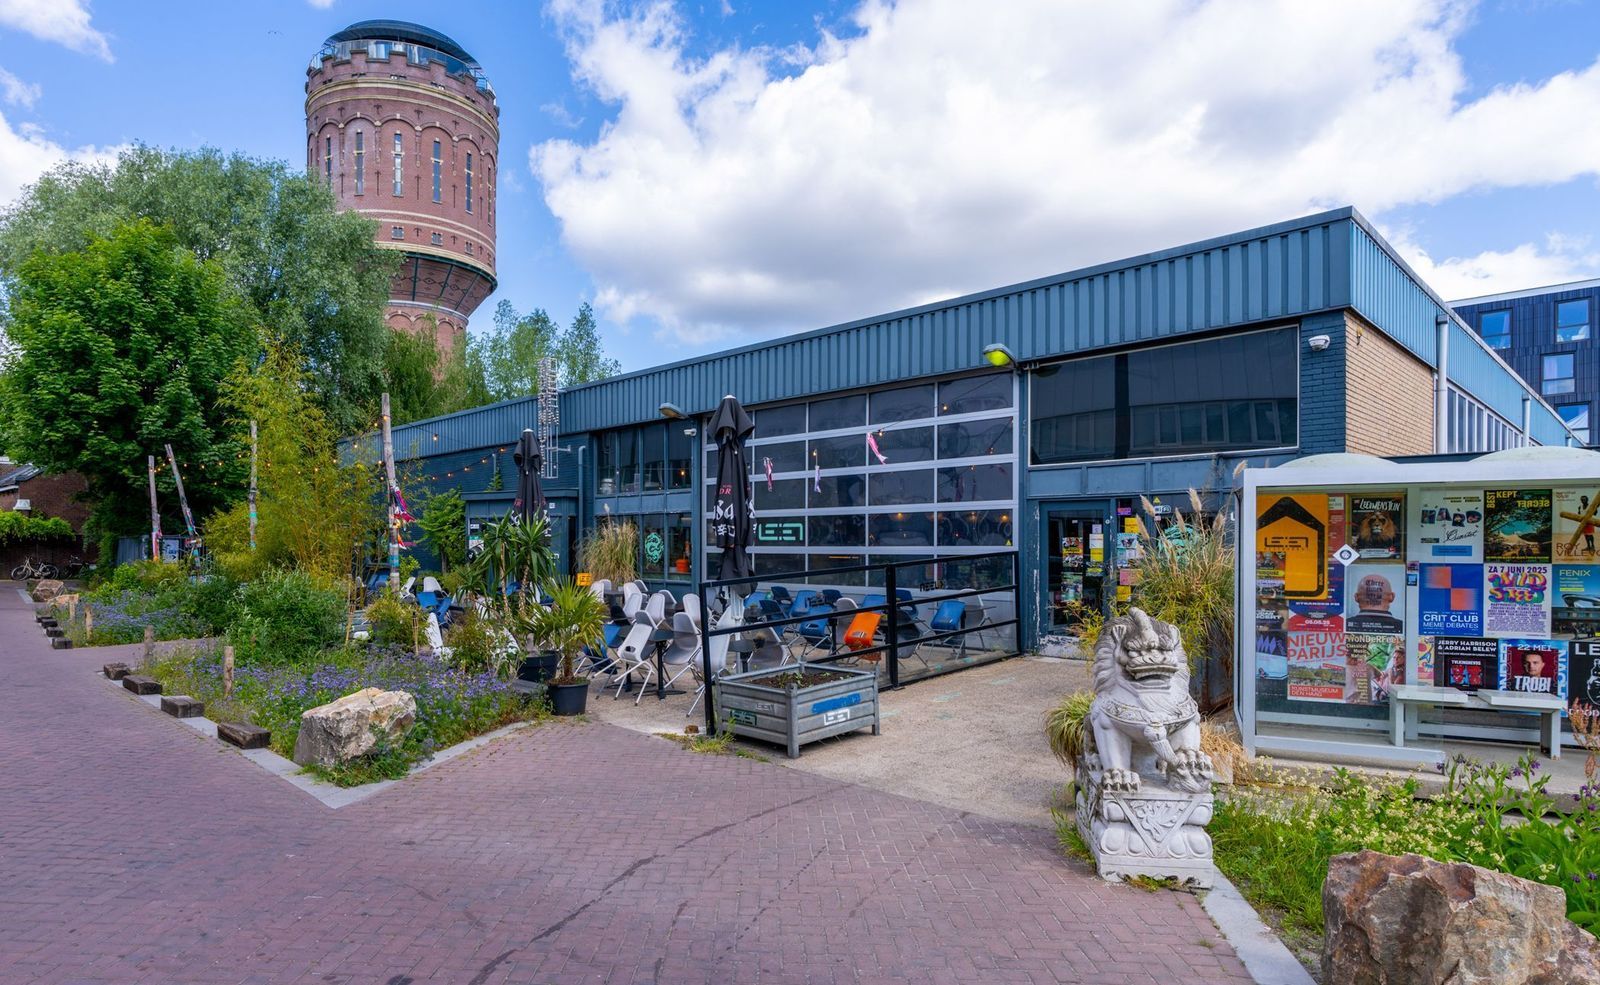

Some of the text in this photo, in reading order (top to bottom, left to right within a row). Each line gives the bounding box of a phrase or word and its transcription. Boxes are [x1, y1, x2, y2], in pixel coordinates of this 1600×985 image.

[1487, 492, 1495, 509] BEST
[1556, 542, 1580, 550] ROY
[1488, 565, 1498, 573] ZA
[1527, 566, 1547, 574] 2025
[1559, 569, 1591, 577] FENIX
[1423, 614, 1479, 623] CRIT CLUB
[1287, 632, 1345, 647] NIEUW
[1517, 643, 1528, 651] 22
[1287, 644, 1346, 661] PARIJS
[1514, 676, 1552, 693] TROBI
[1291, 685, 1338, 694] KUNSTMUSEUM
